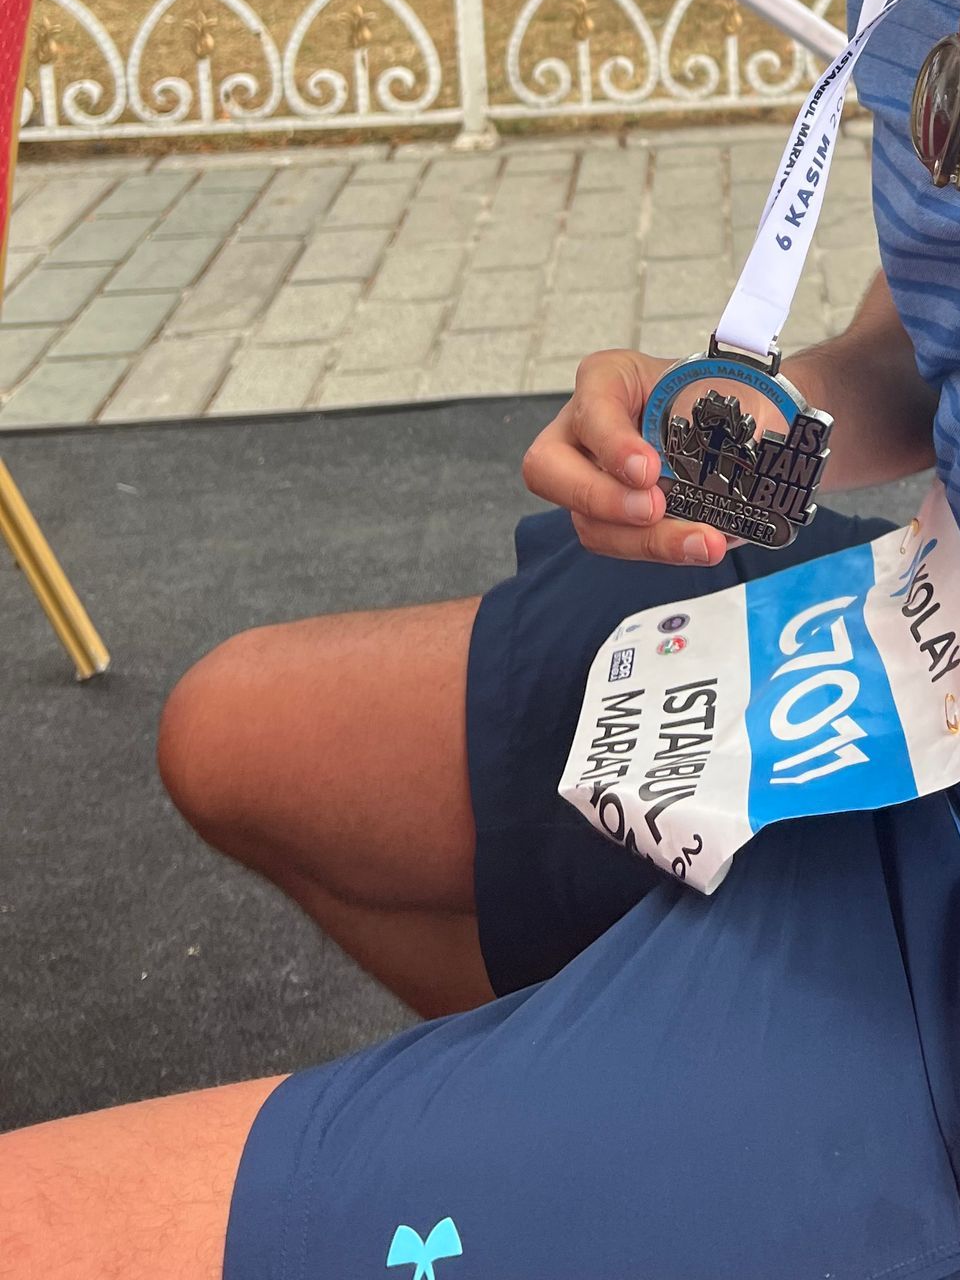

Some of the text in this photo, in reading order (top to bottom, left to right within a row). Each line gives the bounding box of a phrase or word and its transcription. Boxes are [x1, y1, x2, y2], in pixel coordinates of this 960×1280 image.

[804, 51, 853, 118] ISTANBUL
[776, 233, 792, 251] 6
[784, 133, 831, 228] KASIM
[759, 443, 818, 487] TAN
[666, 492, 776, 542] 42K FINISHER
[672, 483, 769, 522] 6 KASIM 2022
[752, 477, 808, 520] BUL
[620, 650, 633, 678] SPOR
[638, 678, 719, 845] ISTANBUL
